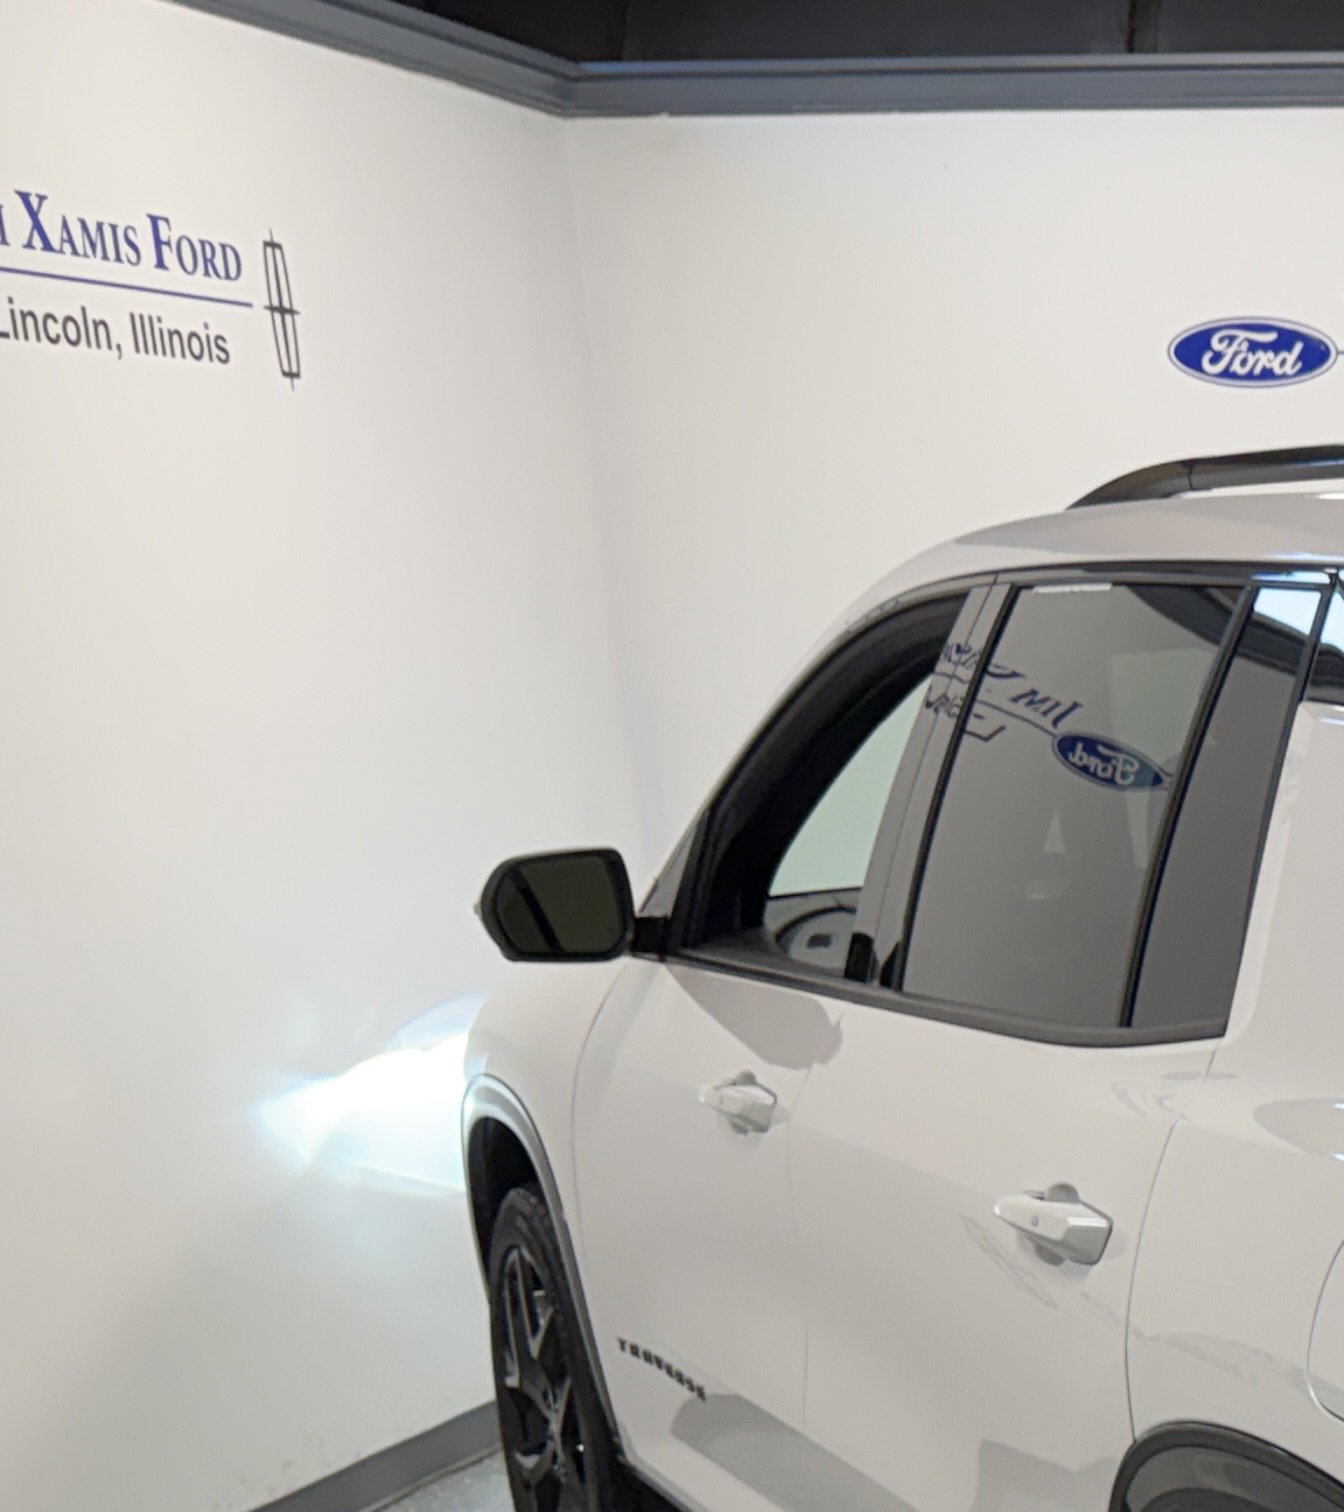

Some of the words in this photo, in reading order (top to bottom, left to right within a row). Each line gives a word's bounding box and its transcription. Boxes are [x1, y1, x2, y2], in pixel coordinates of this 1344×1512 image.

[14, 189, 142, 267] XAMIS
[147, 213, 243, 282] FORD
[130, 311, 231, 365] Illinois
[1201, 329, 1304, 377] Ford
